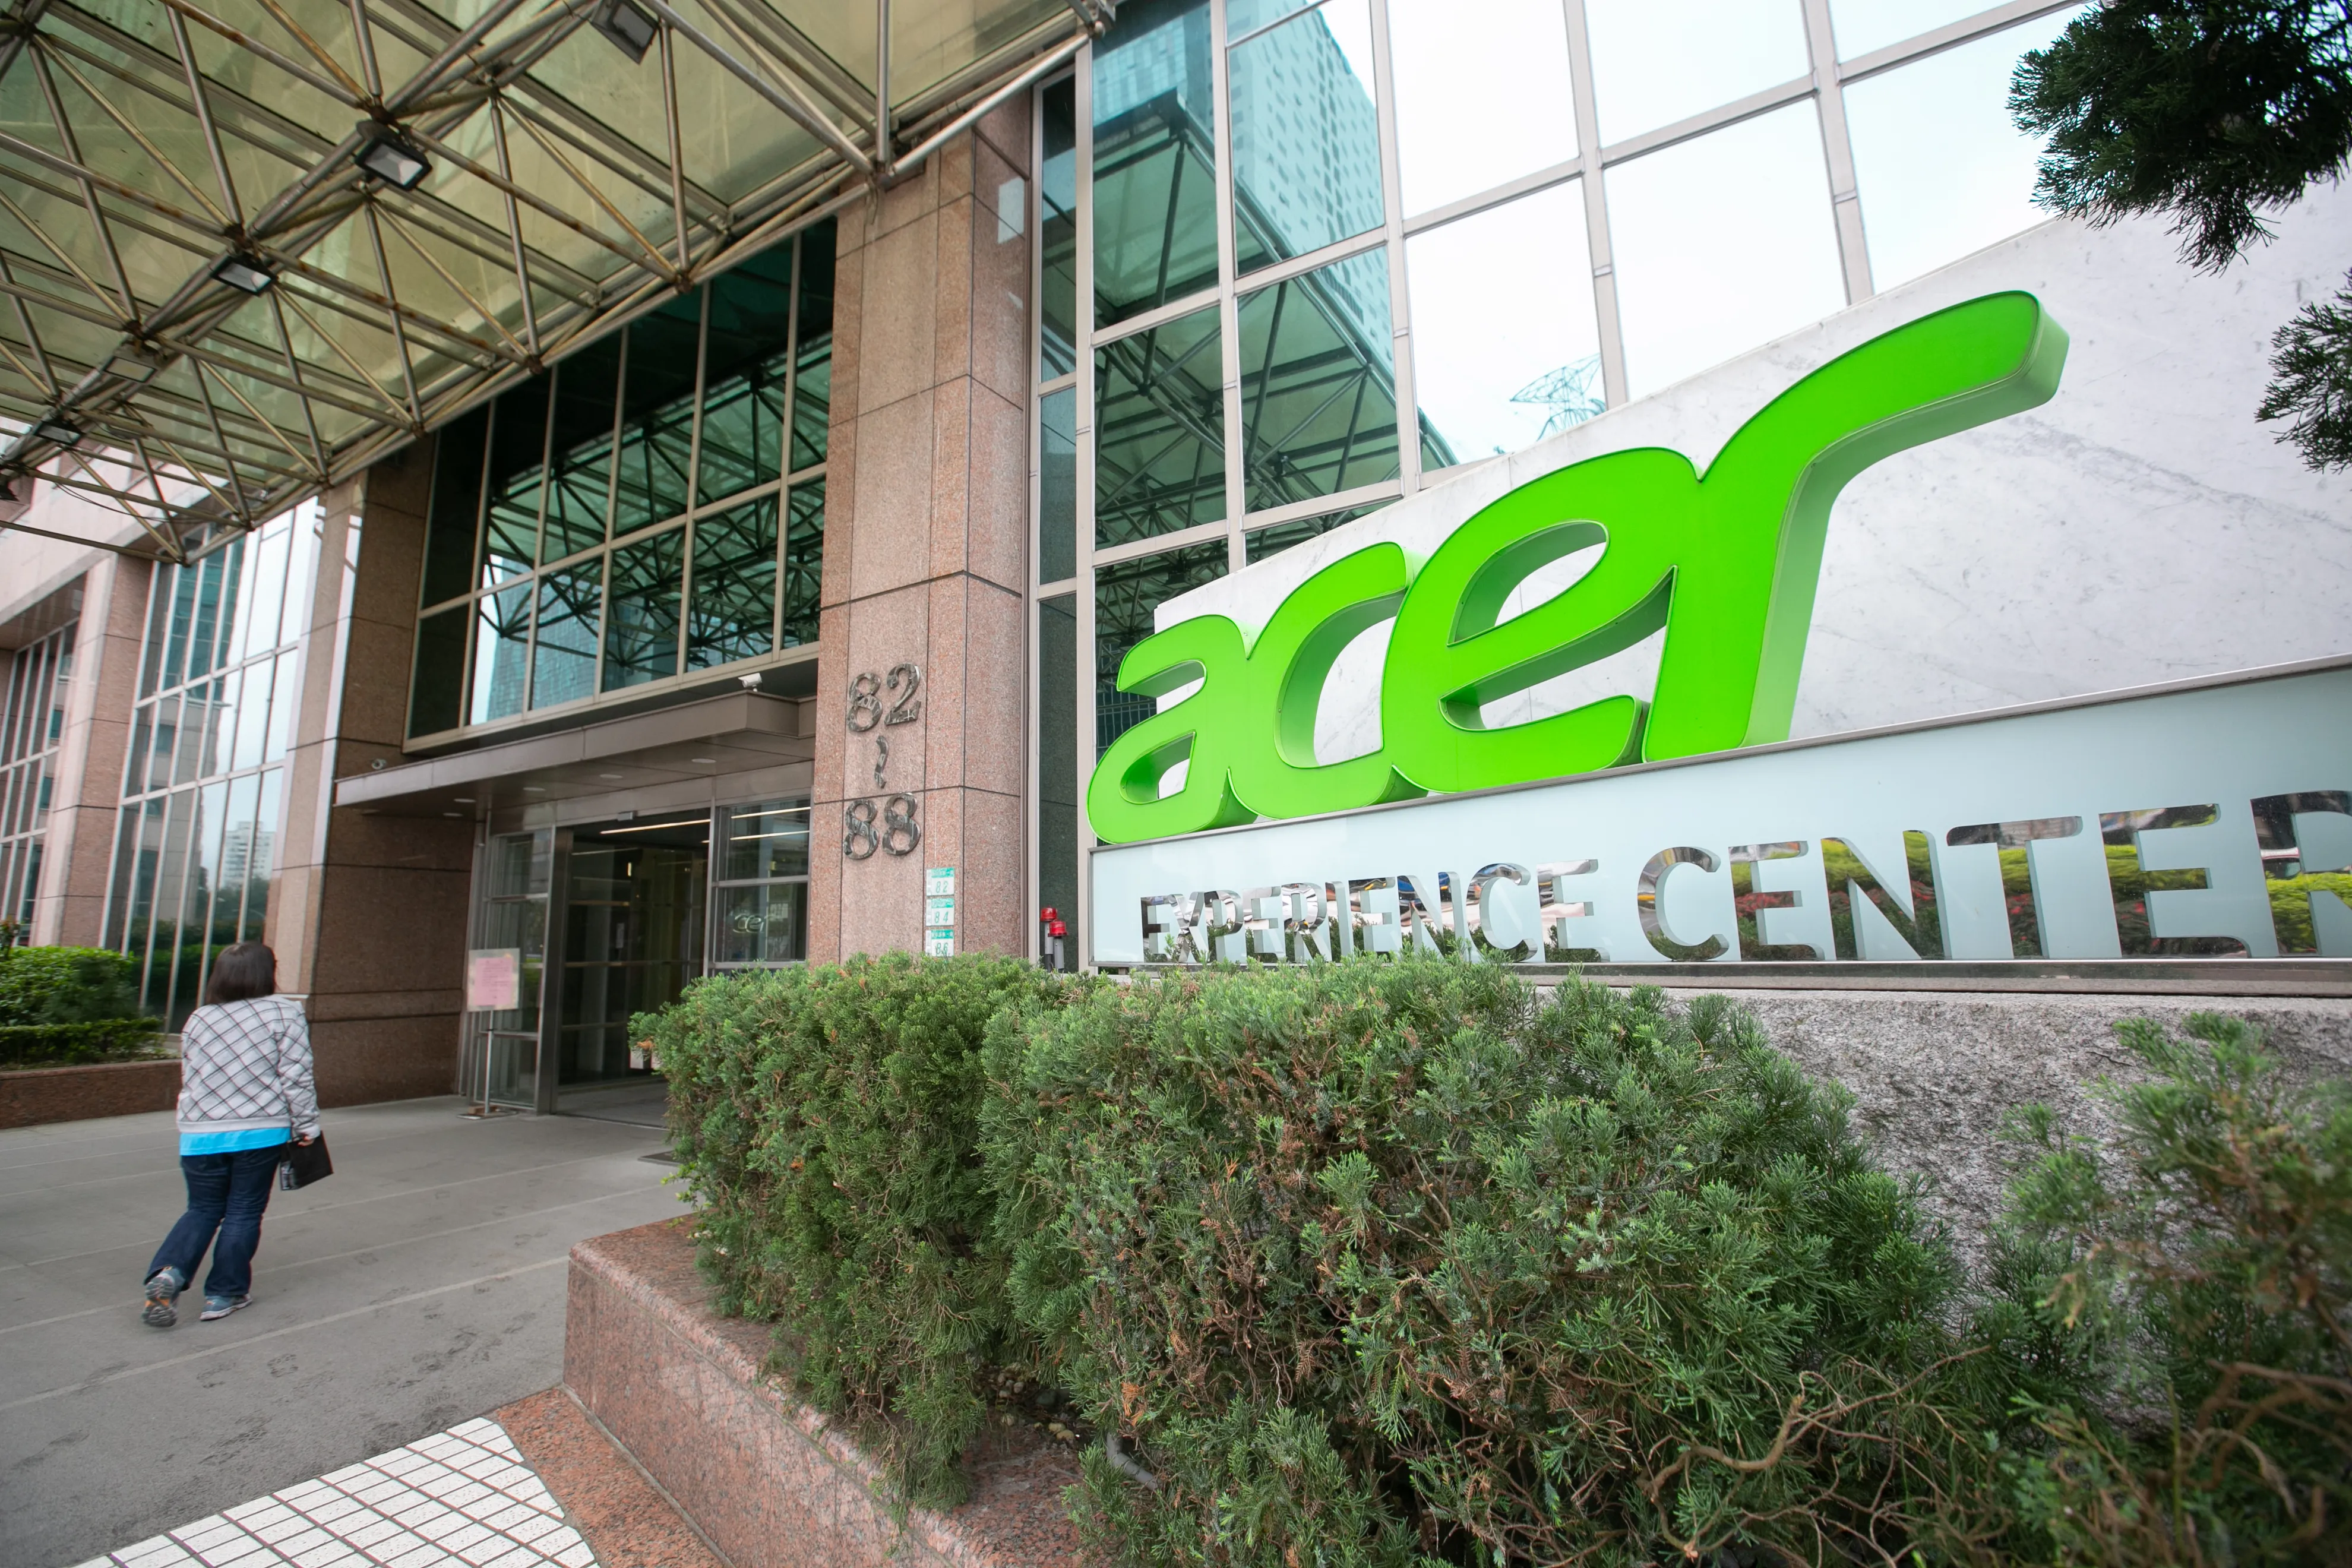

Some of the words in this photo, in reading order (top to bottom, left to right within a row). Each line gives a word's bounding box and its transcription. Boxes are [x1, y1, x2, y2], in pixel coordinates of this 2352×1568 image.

[1087, 290, 2069, 843] acer
[847, 663, 921, 732] 82
[843, 792, 921, 860] 88
[935, 881, 949, 893] 82
[1140, 859, 1610, 963] EXPERIENCE
[1637, 790, 2352, 961] CENTER
[934, 911, 949, 924] 84
